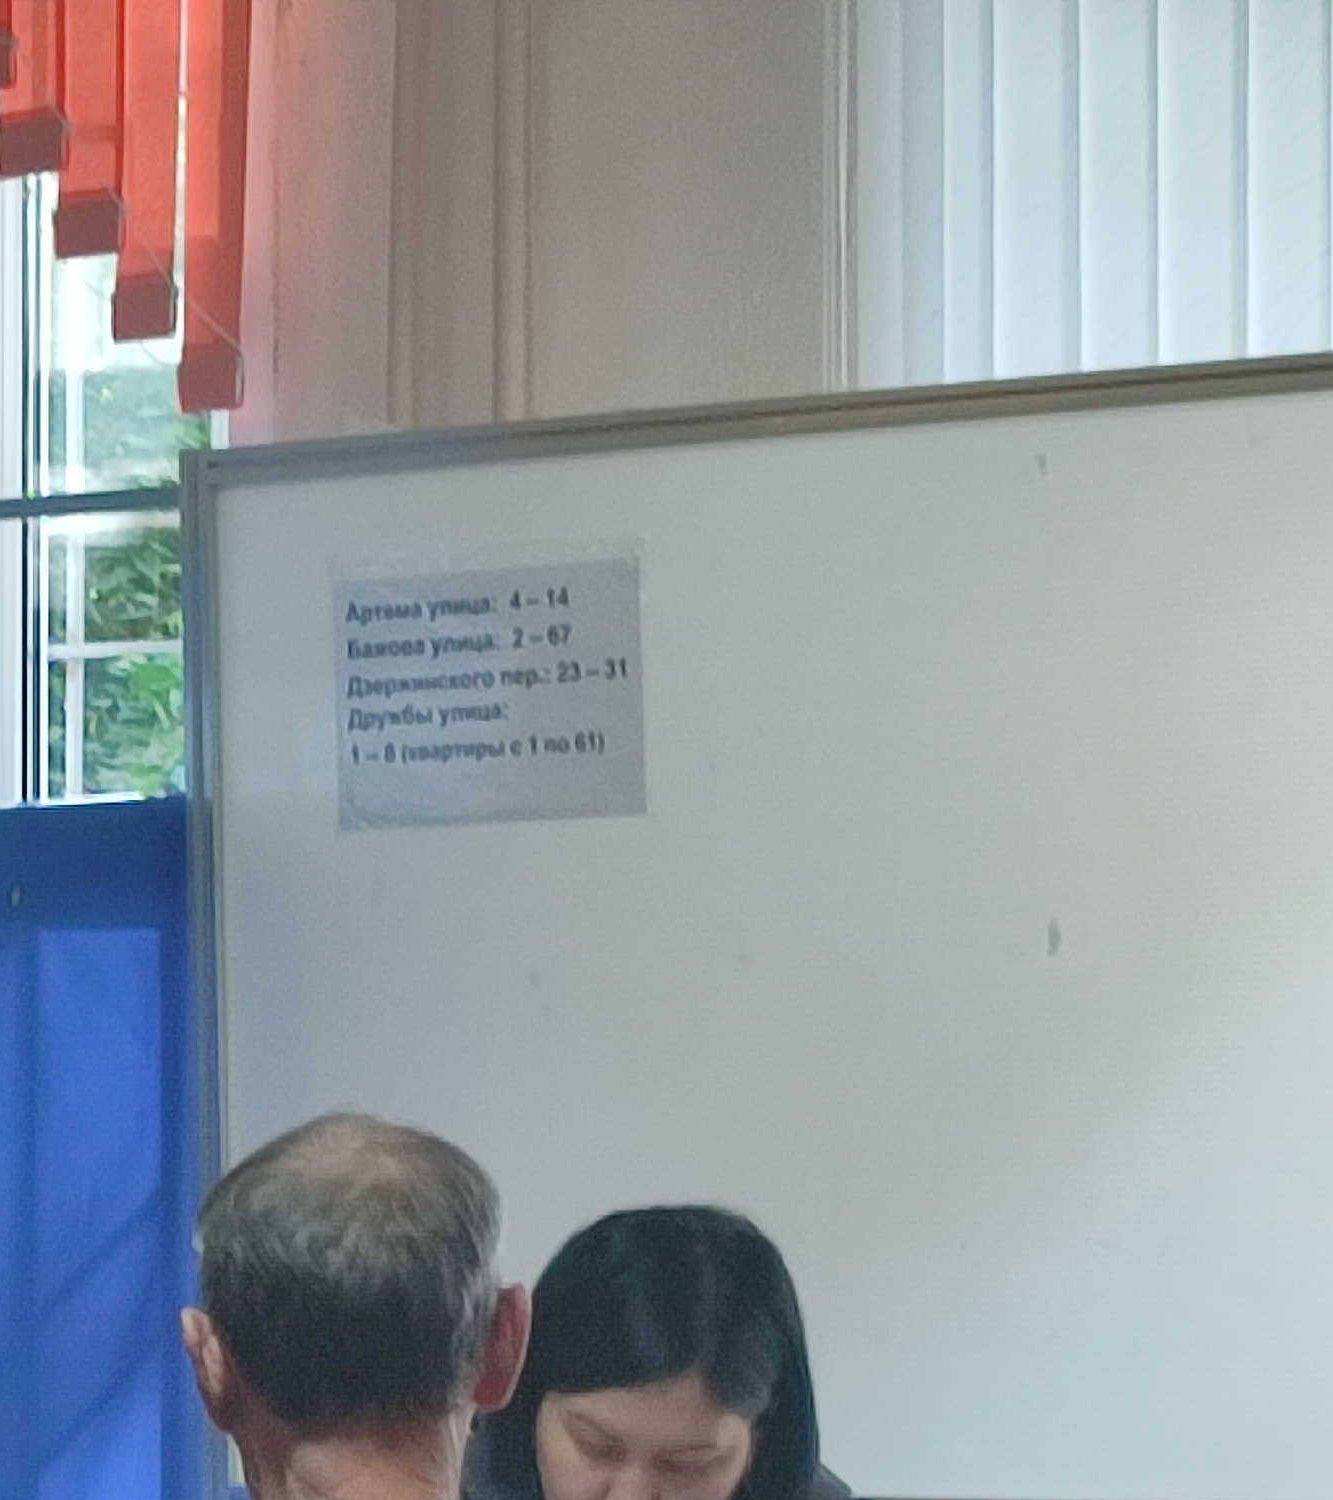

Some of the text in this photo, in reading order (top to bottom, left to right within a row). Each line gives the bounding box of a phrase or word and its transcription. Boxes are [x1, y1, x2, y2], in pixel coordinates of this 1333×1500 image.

[509, 589, 522, 611] 4
[546, 586, 569, 610] 14
[512, 626, 525, 649] 2
[546, 623, 572, 648] 67
[556, 659, 582, 684] 23
[604, 656, 627, 681] 31
[347, 703, 433, 733] Дружбы
[543, 735, 571, 755] по
